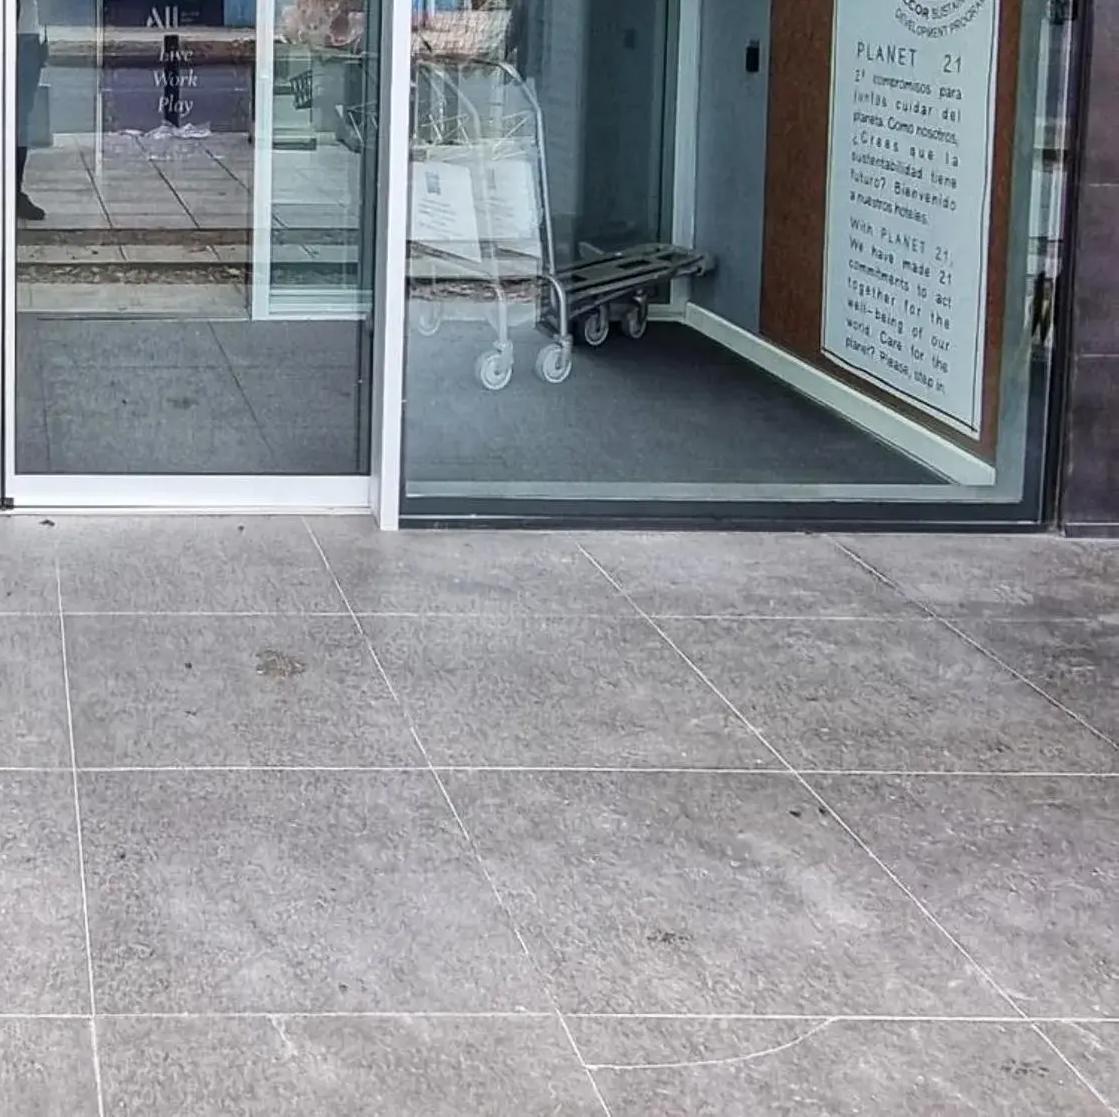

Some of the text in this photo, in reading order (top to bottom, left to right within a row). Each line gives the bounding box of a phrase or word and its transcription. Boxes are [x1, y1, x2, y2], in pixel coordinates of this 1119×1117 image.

[857, 41, 962, 73] PLANET 21
[153, 67, 198, 88] Work
[158, 94, 194, 118] Play
[896, 99, 933, 116] cuidar
[941, 109, 961, 123] del
[887, 117, 914, 134] Como
[910, 147, 934, 161] que
[850, 216, 873, 236] With
[881, 227, 925, 253] PLANET
[939, 270, 952, 285] 21
[935, 293, 952, 309] act
